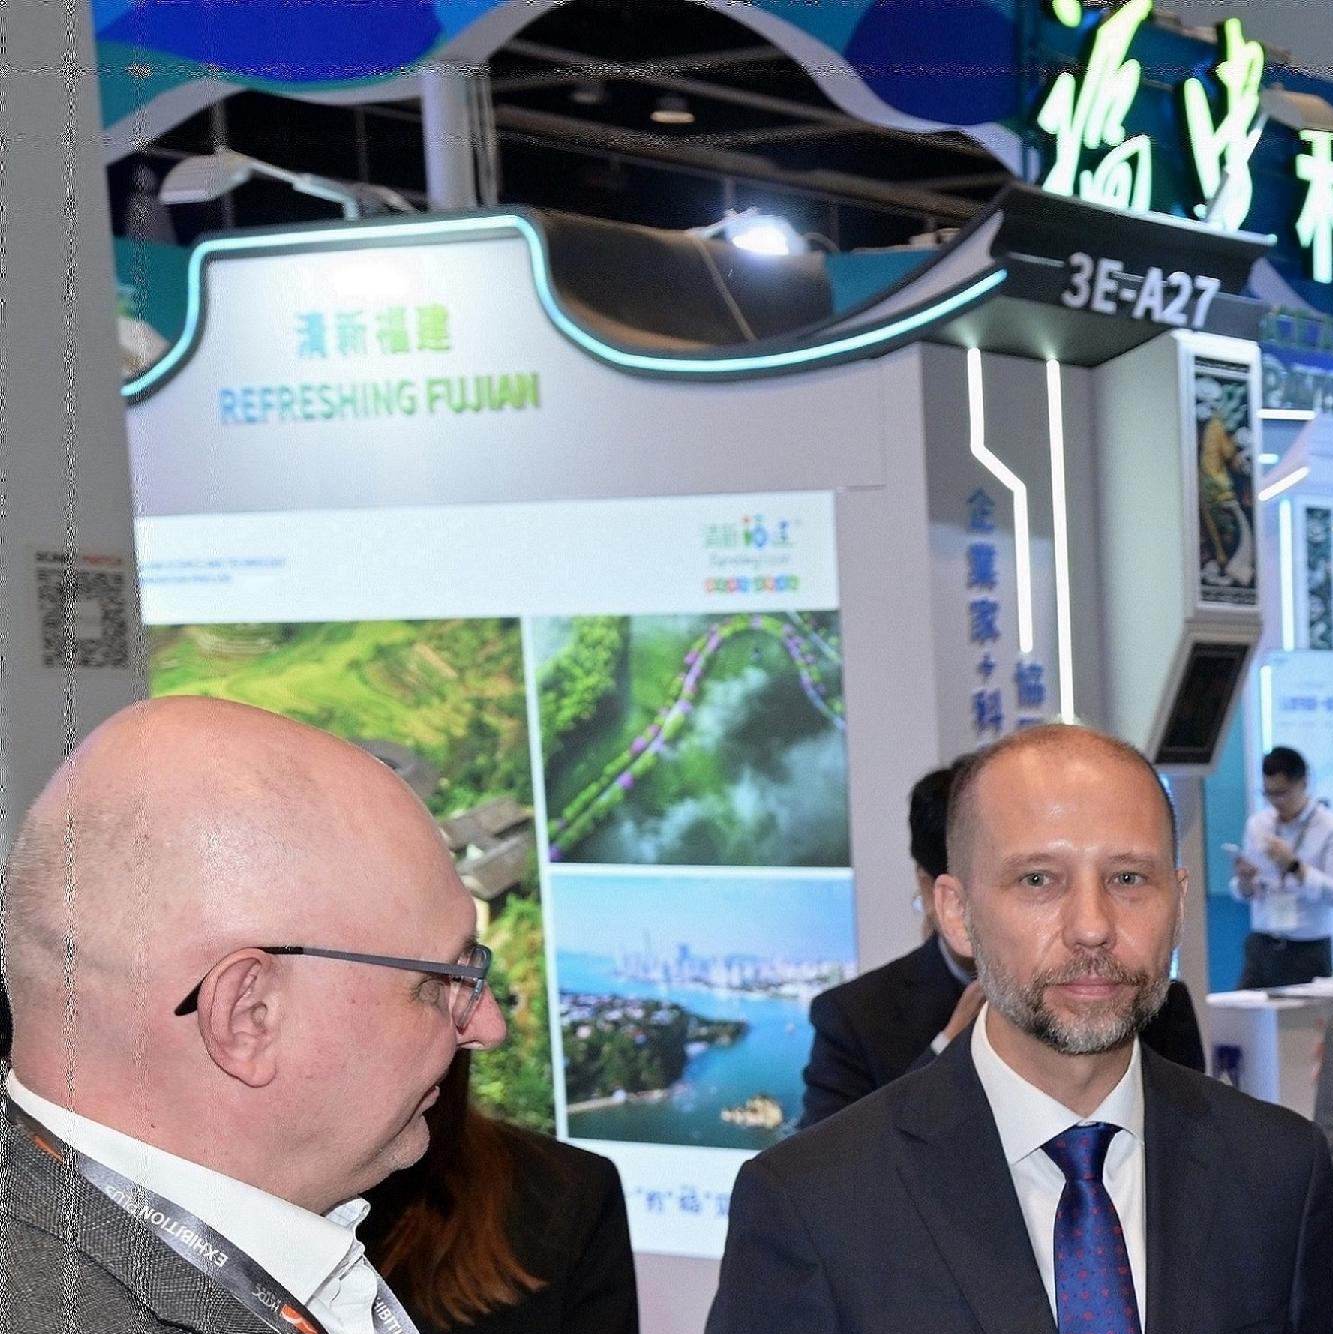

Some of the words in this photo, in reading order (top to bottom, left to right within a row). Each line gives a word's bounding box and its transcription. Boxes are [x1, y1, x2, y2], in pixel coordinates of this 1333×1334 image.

[1062, 252, 1220, 328] 3E-A27
[219, 379, 418, 424] REFRESHING
[425, 371, 541, 414] FUJIAN
[1014, 661, 1047, 726] 協
